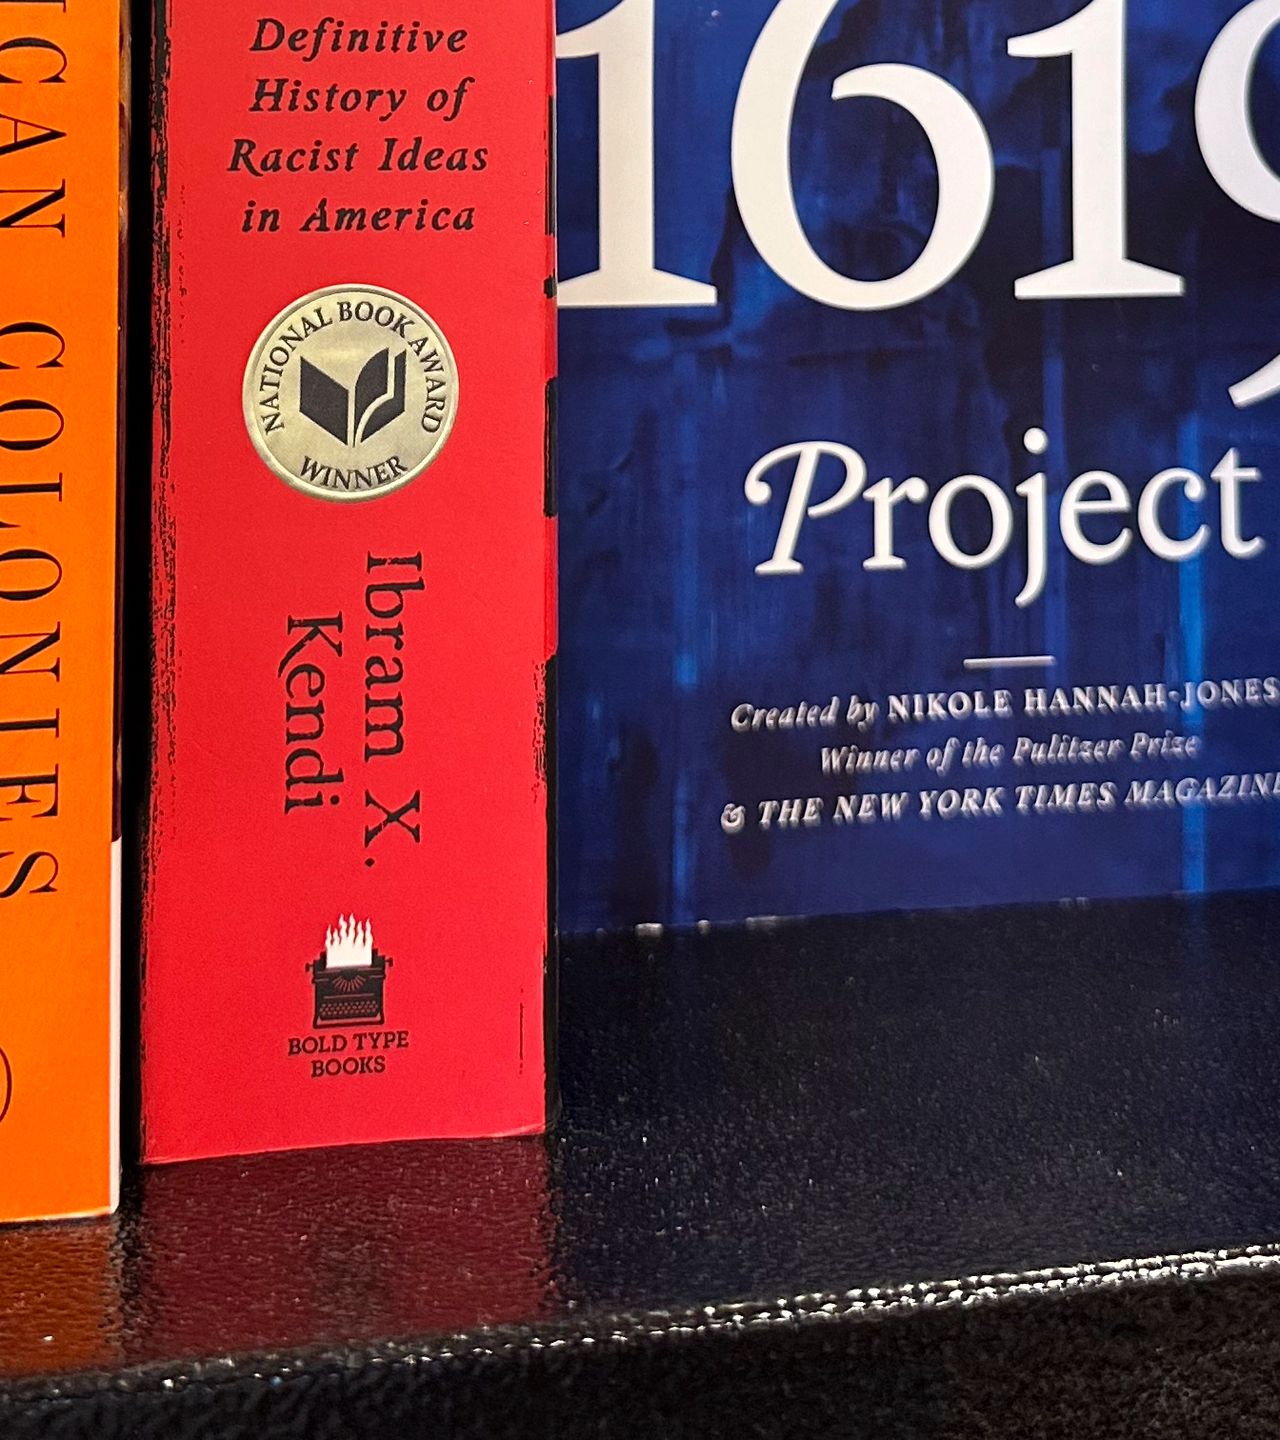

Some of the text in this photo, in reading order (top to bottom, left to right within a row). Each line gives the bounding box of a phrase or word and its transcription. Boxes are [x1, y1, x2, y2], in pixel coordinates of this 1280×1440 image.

[249, 16, 468, 63] Definitive
[248, 76, 476, 123] History of
[227, 136, 489, 174] Racist Ideas
[241, 197, 476, 234] in America
[260, 300, 448, 436] NATIONAL BOOK AWARD
[298, 454, 408, 492] WINNER
[744, 426, 1267, 608] Project
[277, 611, 345, 815] Kendi
[364, 551, 427, 868] Ibram X.
[731, 695, 840, 732] Created
[847, 696, 881, 730] by
[887, 688, 1012, 725] NIKOLE
[820, 729, 1201, 777] Winner of the Pulitzer Prize
[719, 801, 745, 833] &
[757, 796, 824, 828] THE
[832, 791, 909, 824] NEW
[919, 785, 1004, 819] YORK
[1014, 779, 1116, 813] TIMES
[287, 1030, 410, 1056] BOLD TYPE
[310, 1054, 387, 1078] BOOKS
